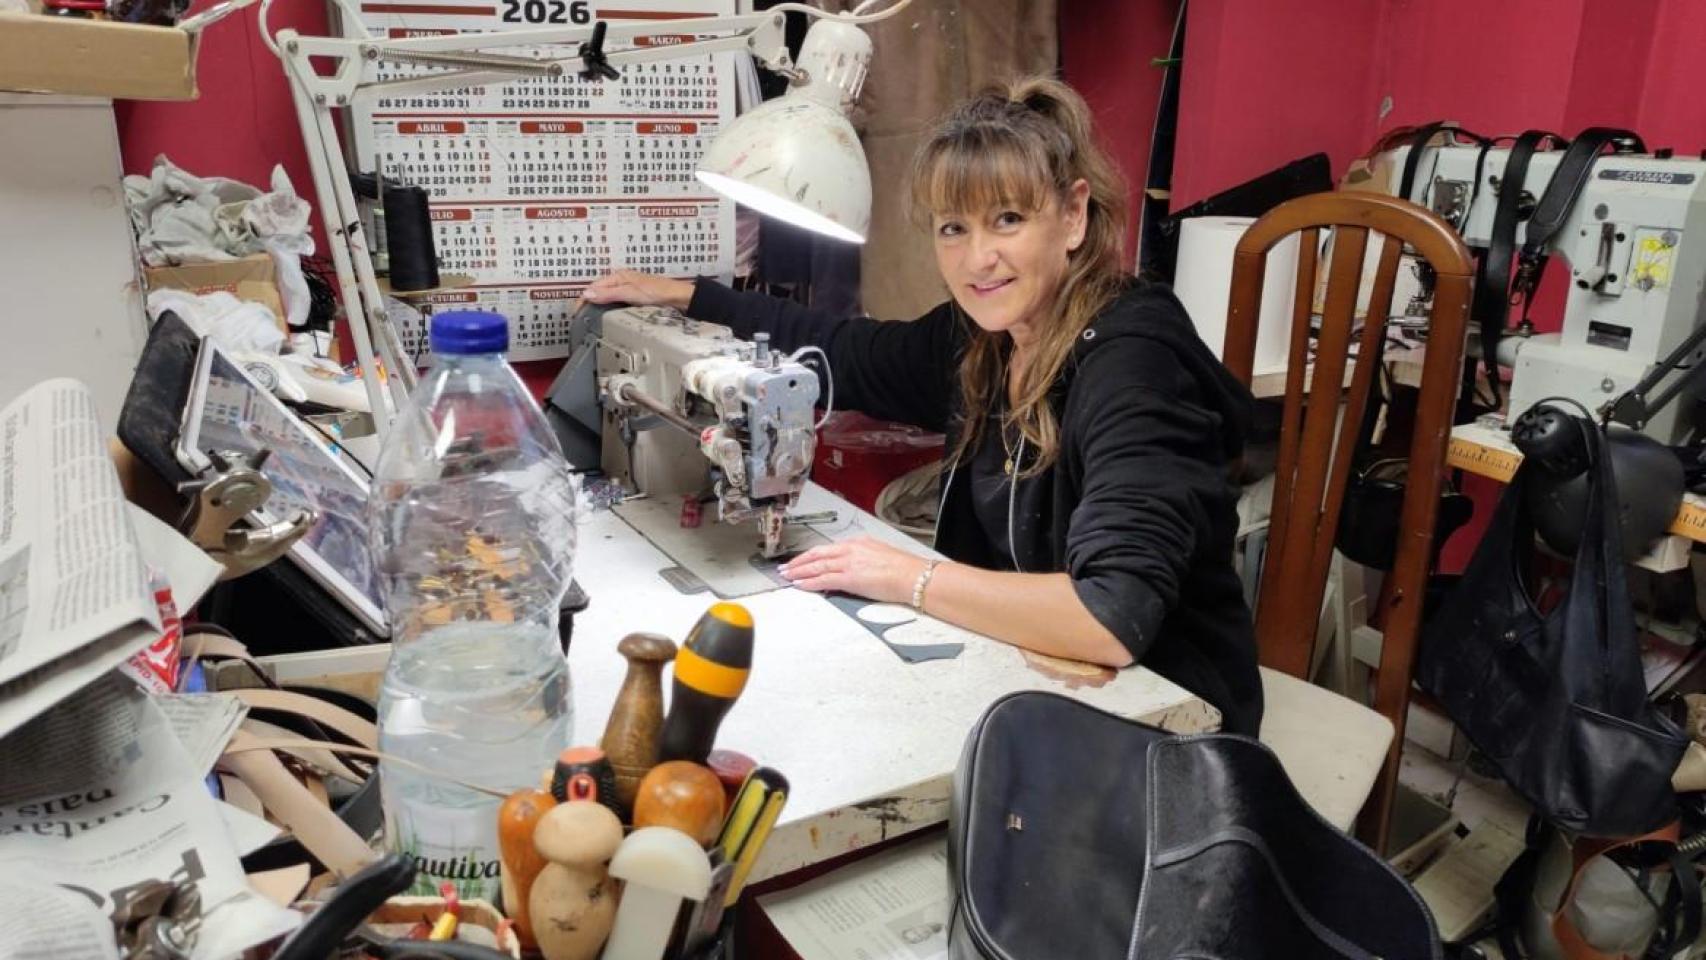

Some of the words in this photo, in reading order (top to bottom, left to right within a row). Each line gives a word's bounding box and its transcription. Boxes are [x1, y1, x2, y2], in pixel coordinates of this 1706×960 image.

[502, 0, 591, 24] 2026
[378, 99, 392, 108] 26
[394, 99, 408, 108] 27
[410, 99, 424, 108] 28
[425, 99, 440, 108] 29
[441, 99, 455, 108] 30
[457, 99, 470, 108] 31
[502, 99, 515, 109] 23
[517, 99, 531, 109] 24
[532, 99, 546, 109] 25
[547, 99, 561, 109] 26
[562, 99, 576, 109] 27
[577, 99, 591, 109] 28
[415, 122, 448, 133] ABRIL
[538, 122, 566, 133] MAYO
[652, 123, 682, 133] JUNIO
[430, 210, 455, 220] ULIO
[536, 208, 576, 219] AGOSTO
[639, 207, 697, 217] SEPTIEMBRE
